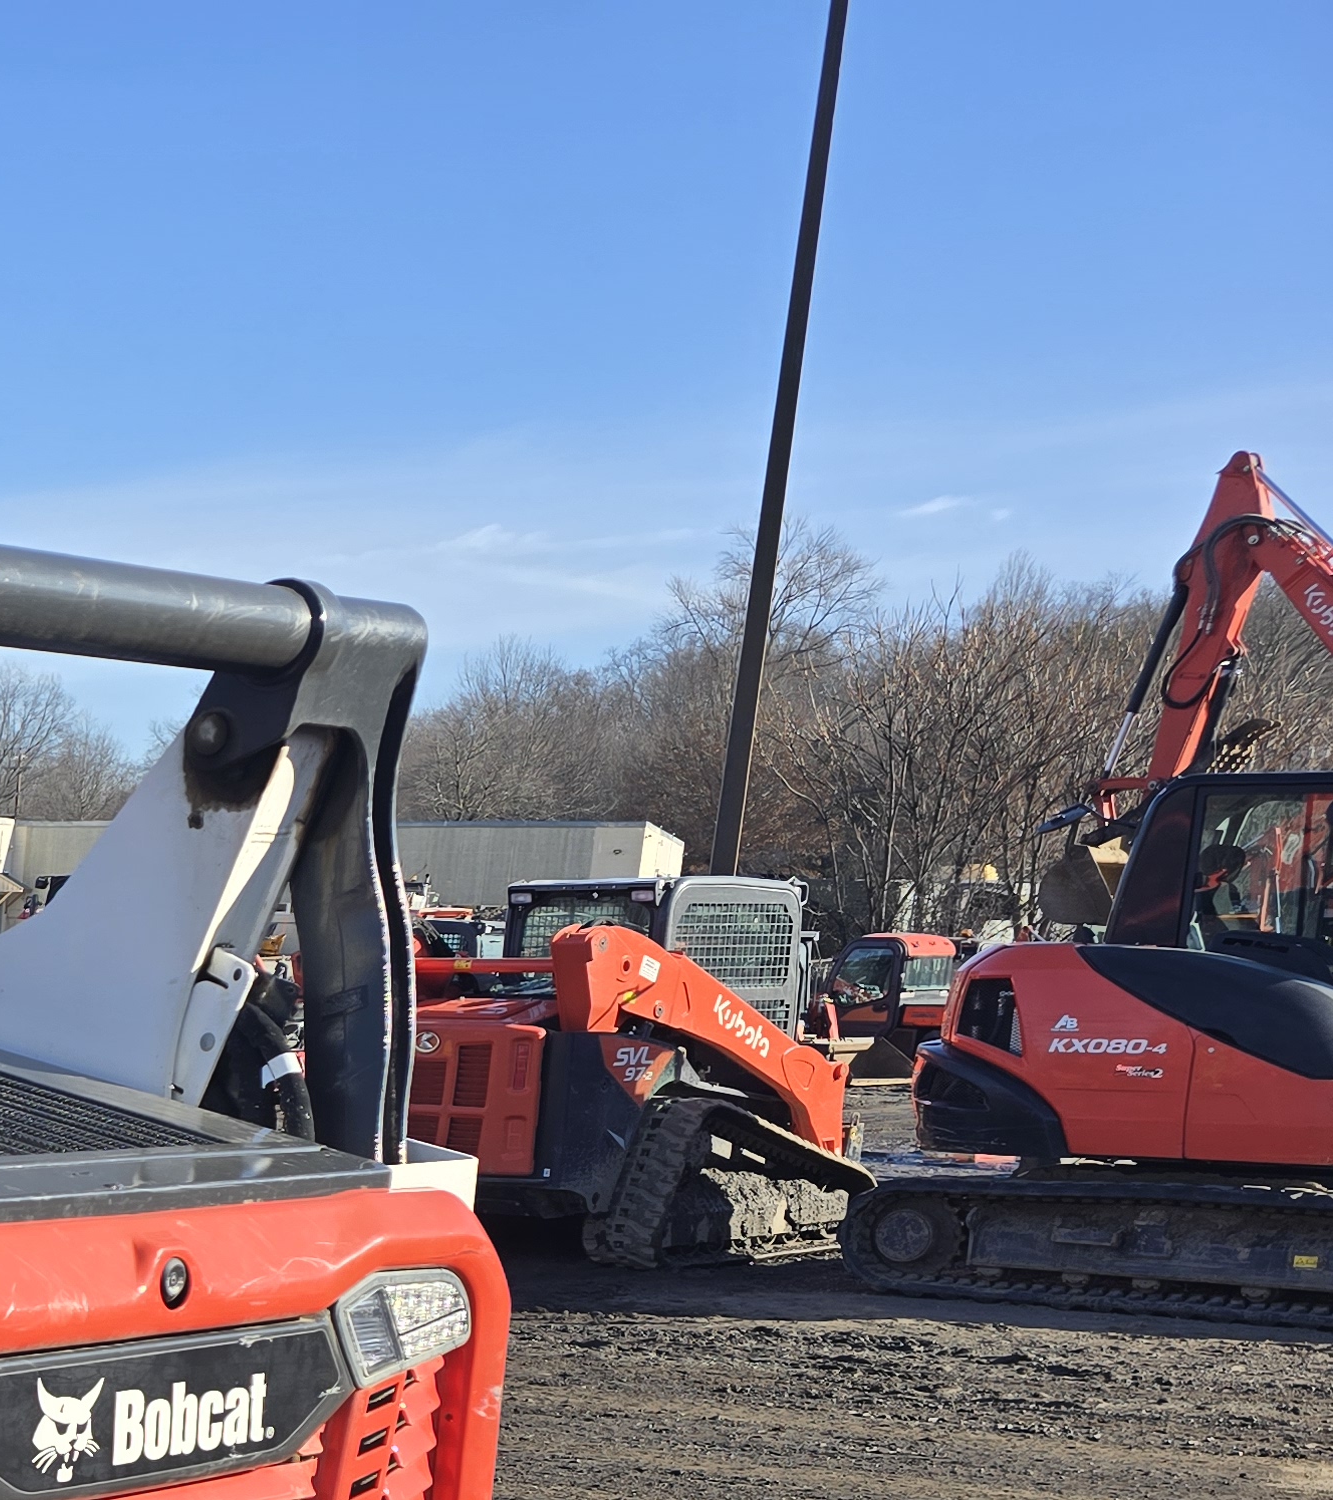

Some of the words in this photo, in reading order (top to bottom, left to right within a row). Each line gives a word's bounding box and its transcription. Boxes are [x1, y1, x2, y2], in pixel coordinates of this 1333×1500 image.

[713, 993, 770, 1059] Kubota
[613, 1046, 654, 1067] SVL
[1048, 1038, 1168, 1054] KX080-4
[623, 1067, 653, 1082] 97-2
[112, 1372, 267, 1466] Bobcat
